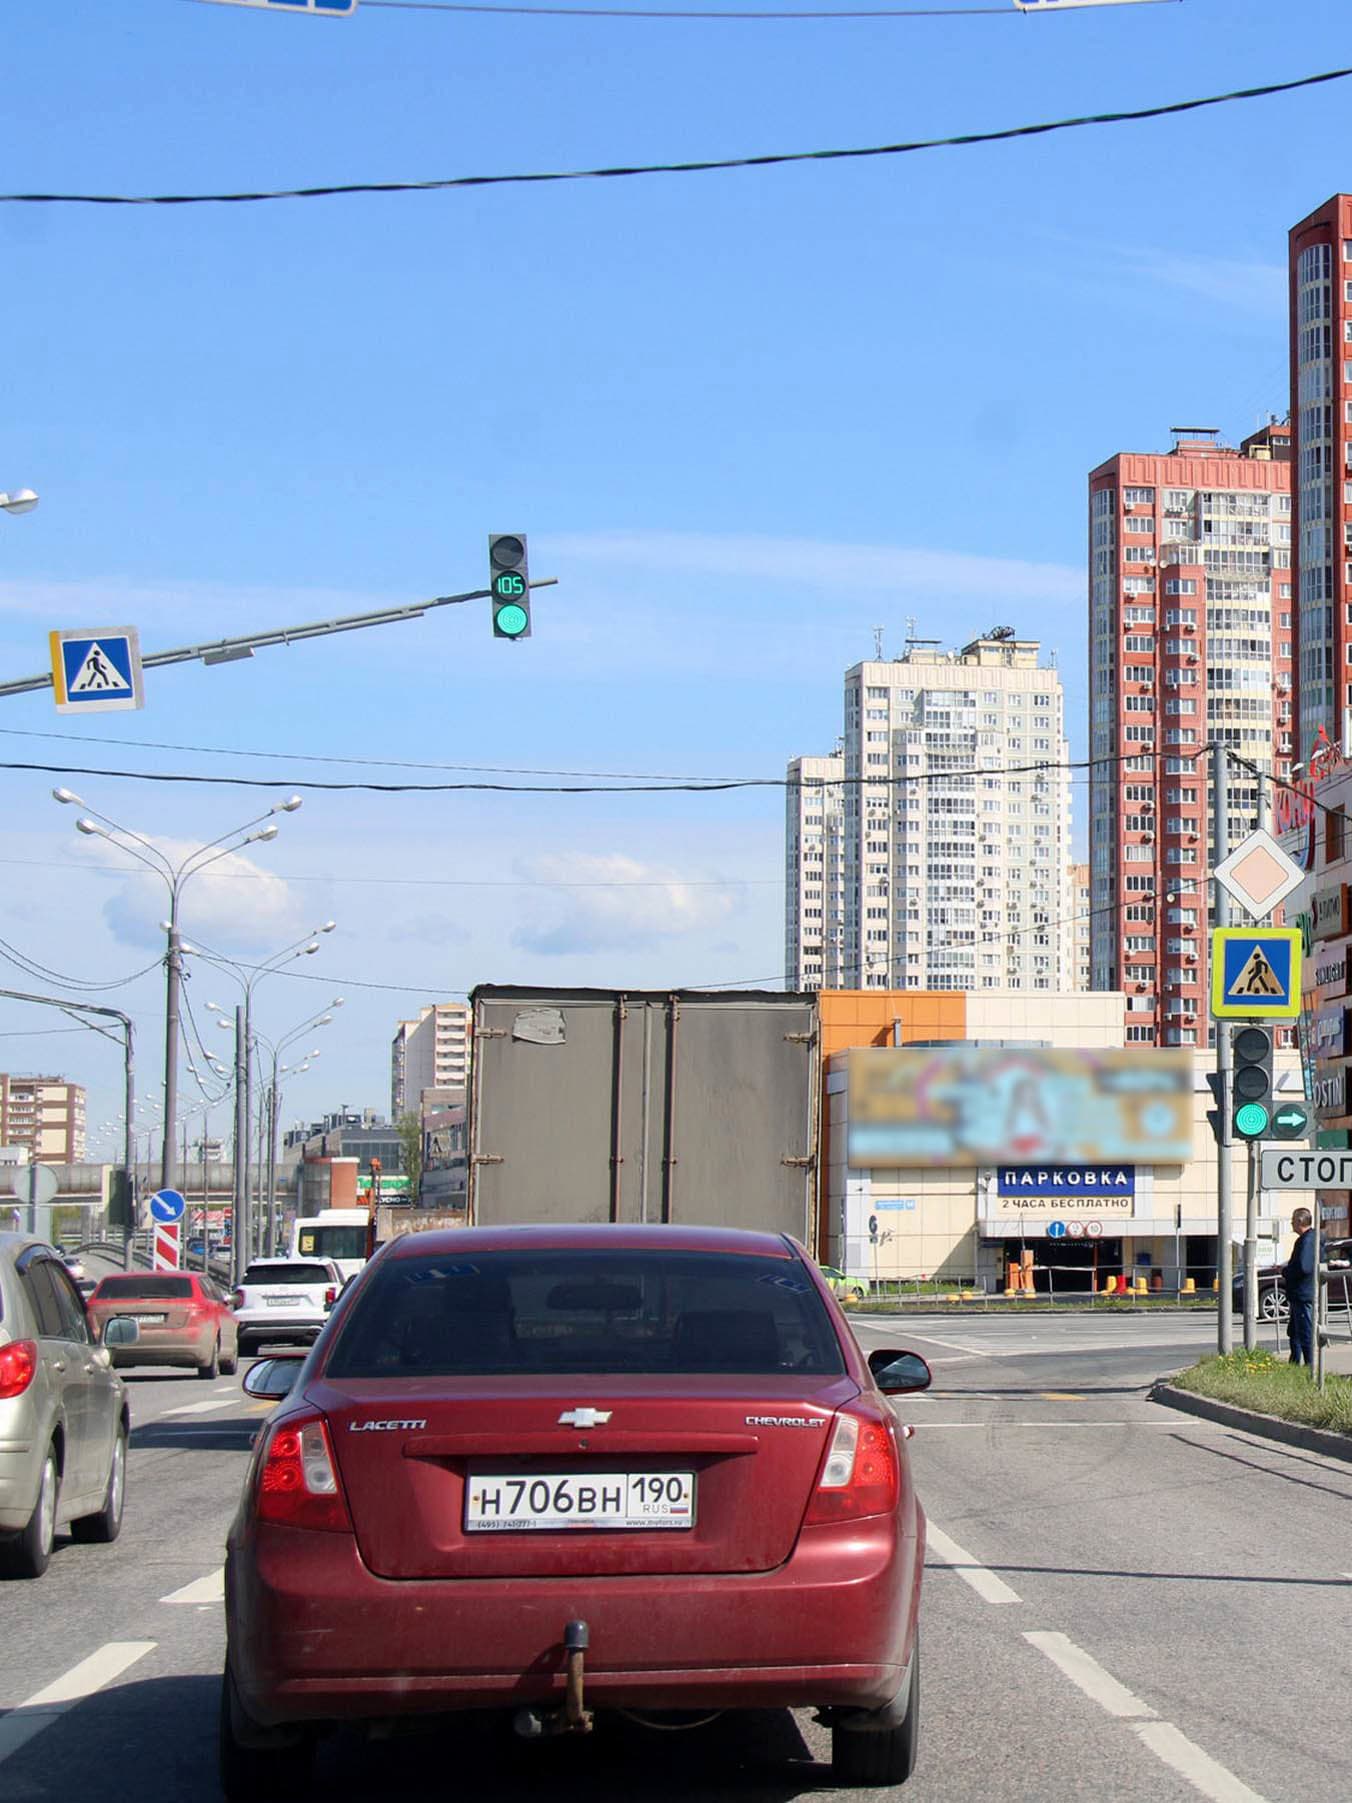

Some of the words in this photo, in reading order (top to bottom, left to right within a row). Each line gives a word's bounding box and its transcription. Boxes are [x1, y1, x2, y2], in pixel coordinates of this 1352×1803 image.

[497, 576, 524, 594] 105
[1005, 1171, 1128, 1185] ПАРКОВКА
[1002, 1199, 1009, 1208] 2
[1012, 1199, 1046, 1208] ЧАСА
[1050, 1199, 1129, 1208] БЕСПЛАТНО
[350, 1419, 427, 1431] LACETTI
[745, 1416, 825, 1428] CHEVROLET
[632, 1477, 683, 1503] 190
[642, 1504, 669, 1514] RUS
